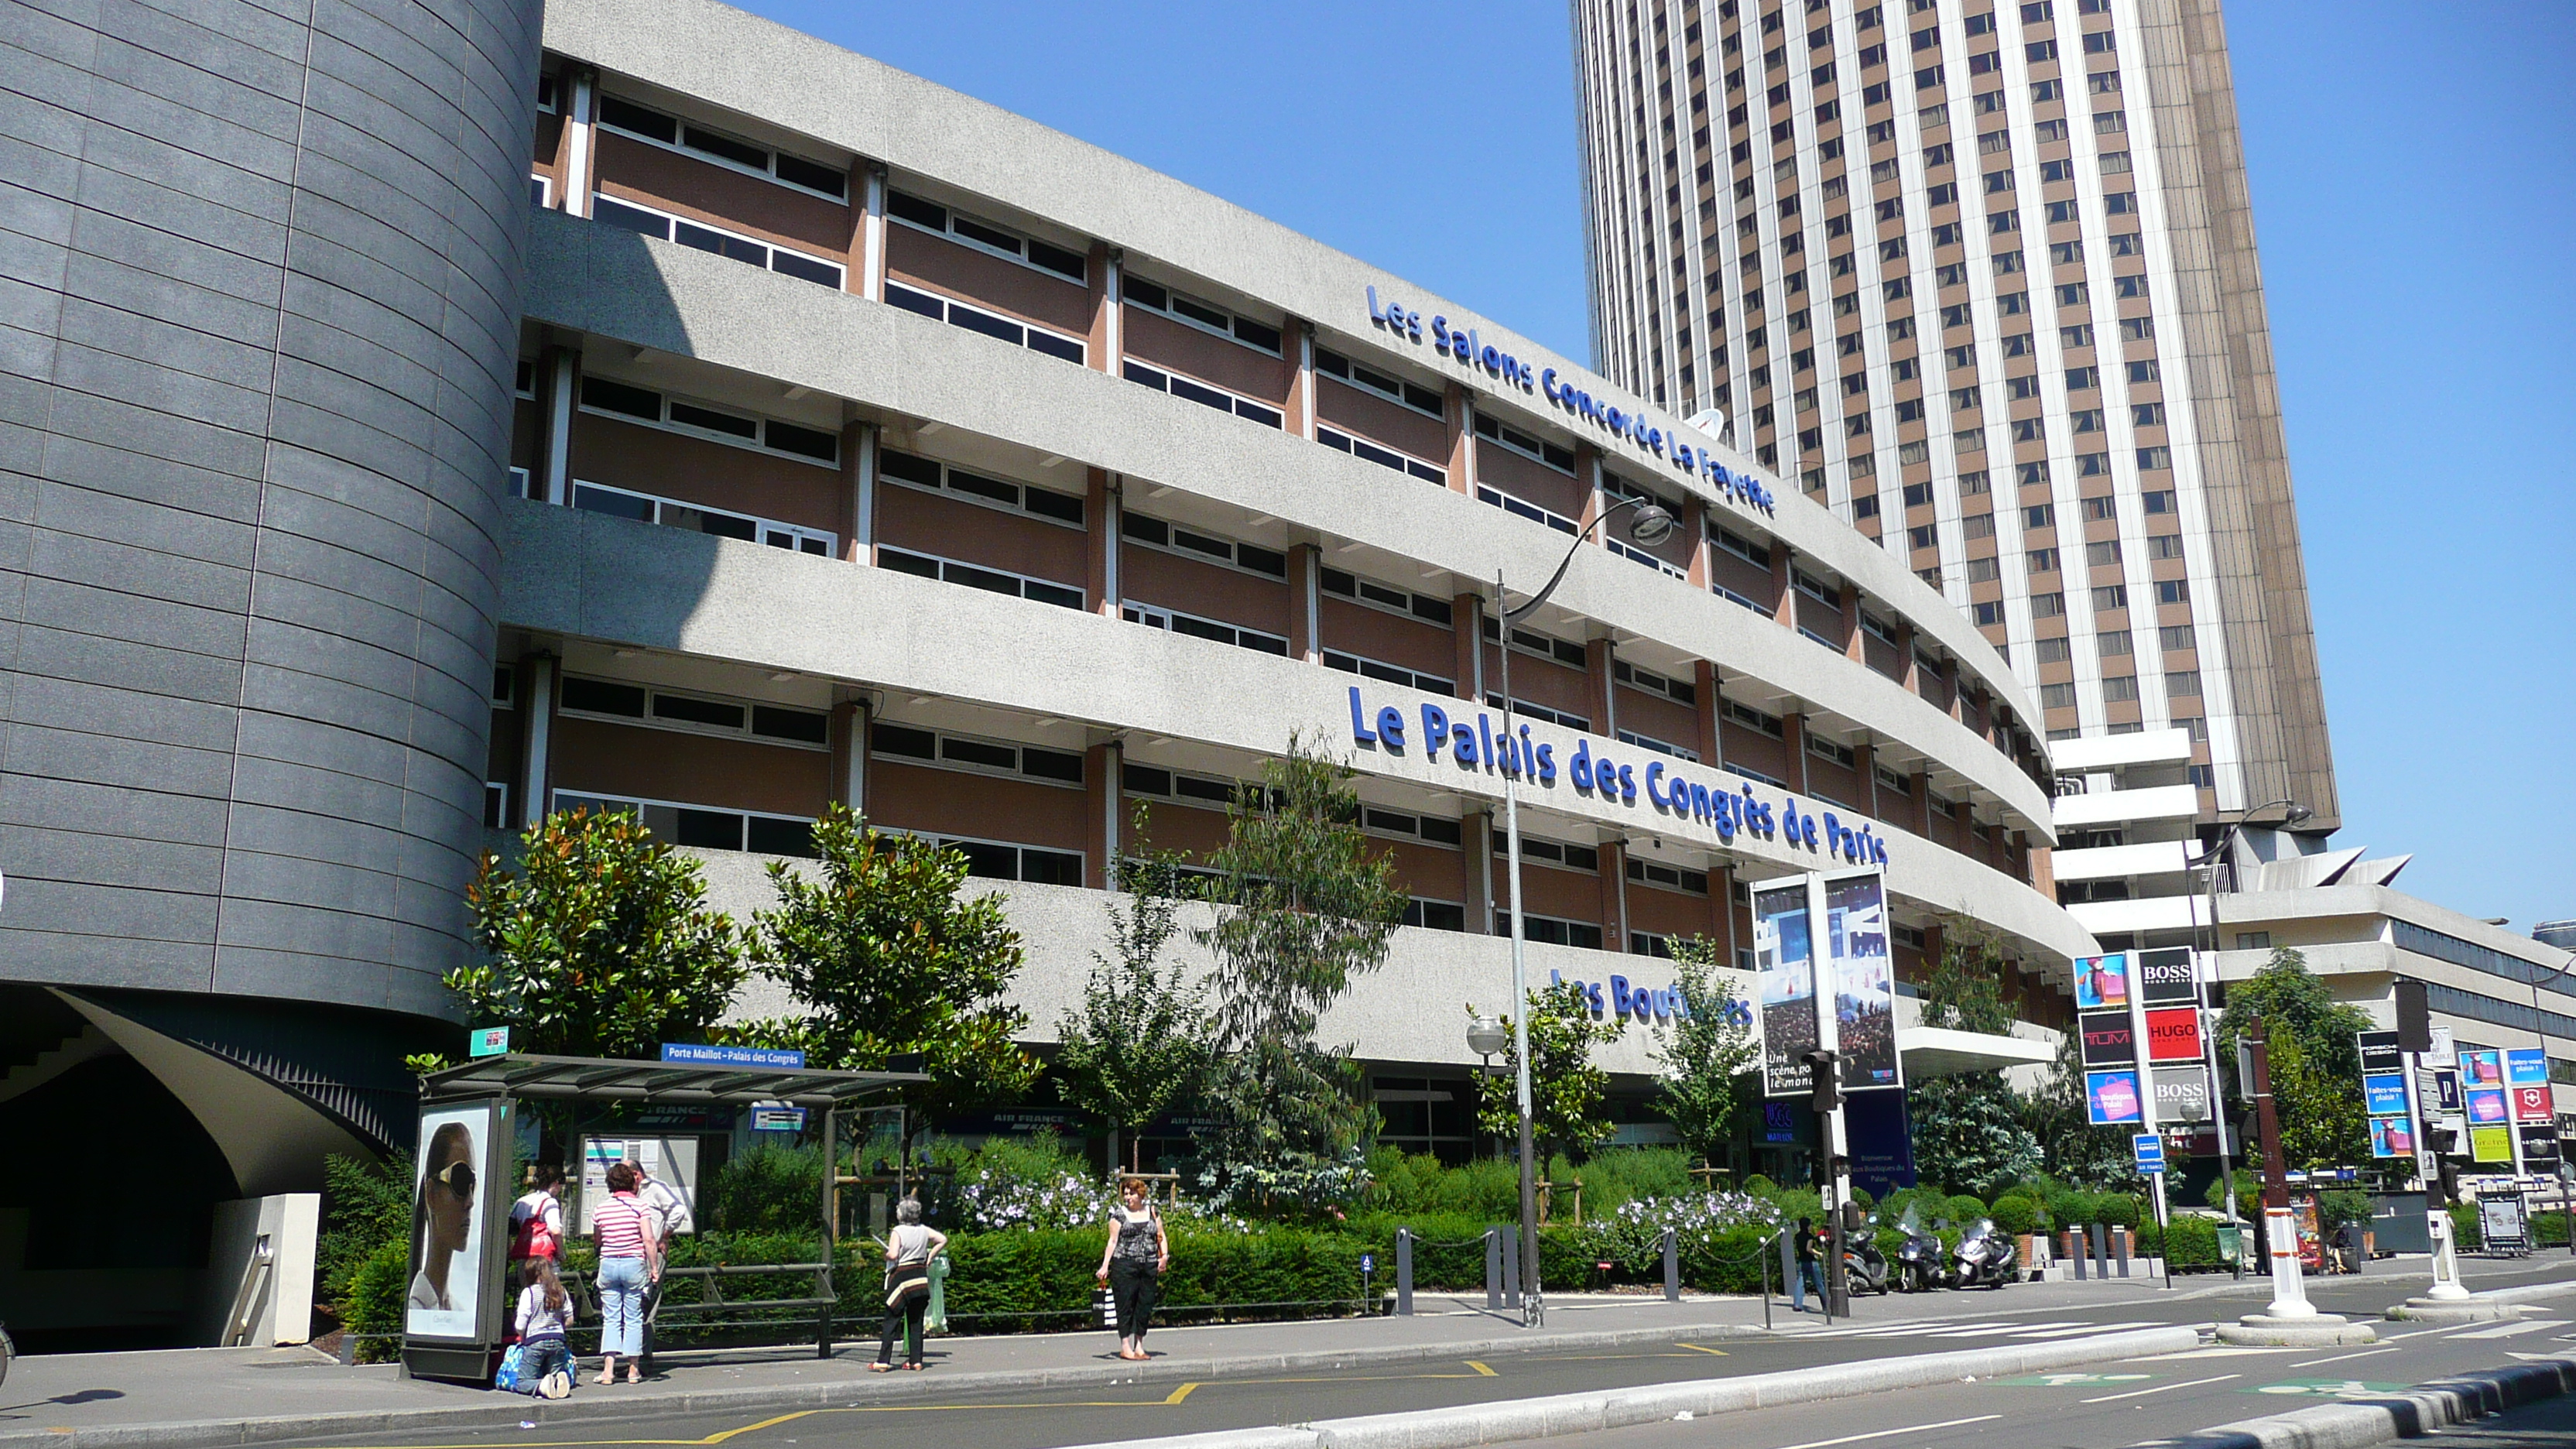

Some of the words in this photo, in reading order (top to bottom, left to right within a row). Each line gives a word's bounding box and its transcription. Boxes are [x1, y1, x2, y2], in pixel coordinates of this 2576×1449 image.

[1366, 284, 1423, 336] Les
[1431, 314, 1534, 388] Salons
[1541, 368, 1663, 451] Concorde
[1667, 430, 1695, 469] La
[1697, 447, 1776, 512] Fayette
[1348, 686, 1406, 747] Le
[1420, 703, 1557, 779] Palais
[1570, 738, 1637, 798] des
[1646, 761, 1776, 838] Congrès
[1782, 797, 1819, 845] de
[1823, 811, 1889, 865] Paris
[2143, 964, 2191, 980] BOSS
[2150, 1024, 2196, 1038] HUGO
[669, 1047, 691, 1058] Porte
[693, 1049, 721, 1060] Maillot
[728, 1050, 751, 1061] Palais
[752, 1052, 766, 1063] des
[768, 1053, 798, 1065] Congrès
[1769, 1053, 1788, 1064] Une
[1769, 1065, 1795, 1076] scène
[1770, 1078, 1780, 1088] le
[2156, 1083, 2204, 1098] BOSS
[1019, 1114, 1064, 1123] FRANCE
[1766, 1102, 1793, 1128] UGC
[1865, 1165, 1896, 1173] Boutiques
